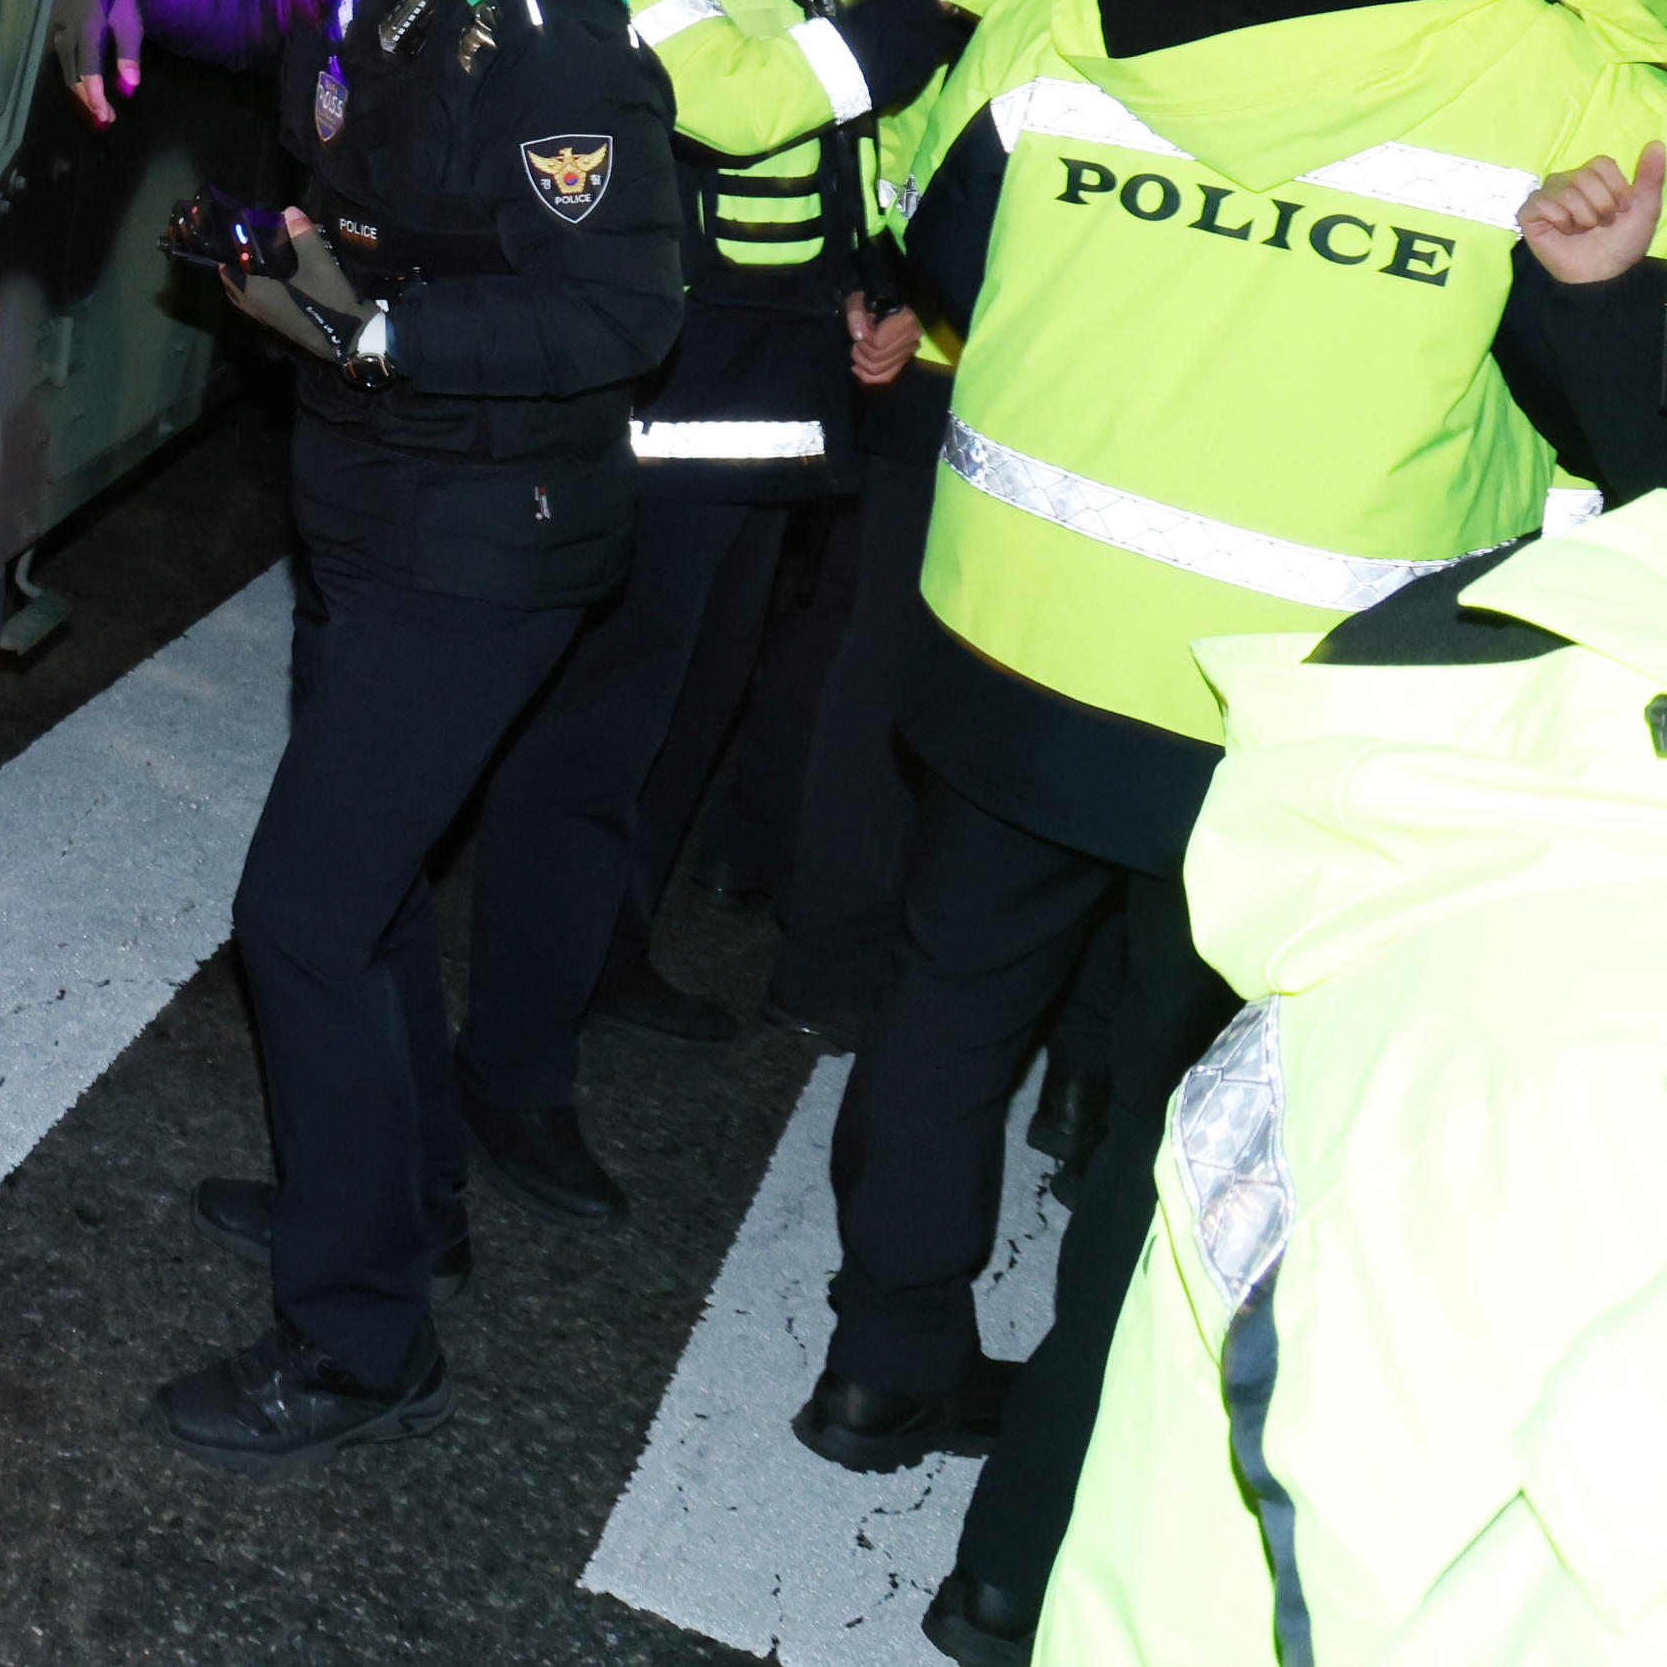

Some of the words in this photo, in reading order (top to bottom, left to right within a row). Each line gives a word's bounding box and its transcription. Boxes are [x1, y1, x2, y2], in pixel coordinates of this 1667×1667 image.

[554, 193, 592, 205] POLICE
[339, 218, 378, 240] POLICE
[1054, 156, 1457, 288] POLICE
